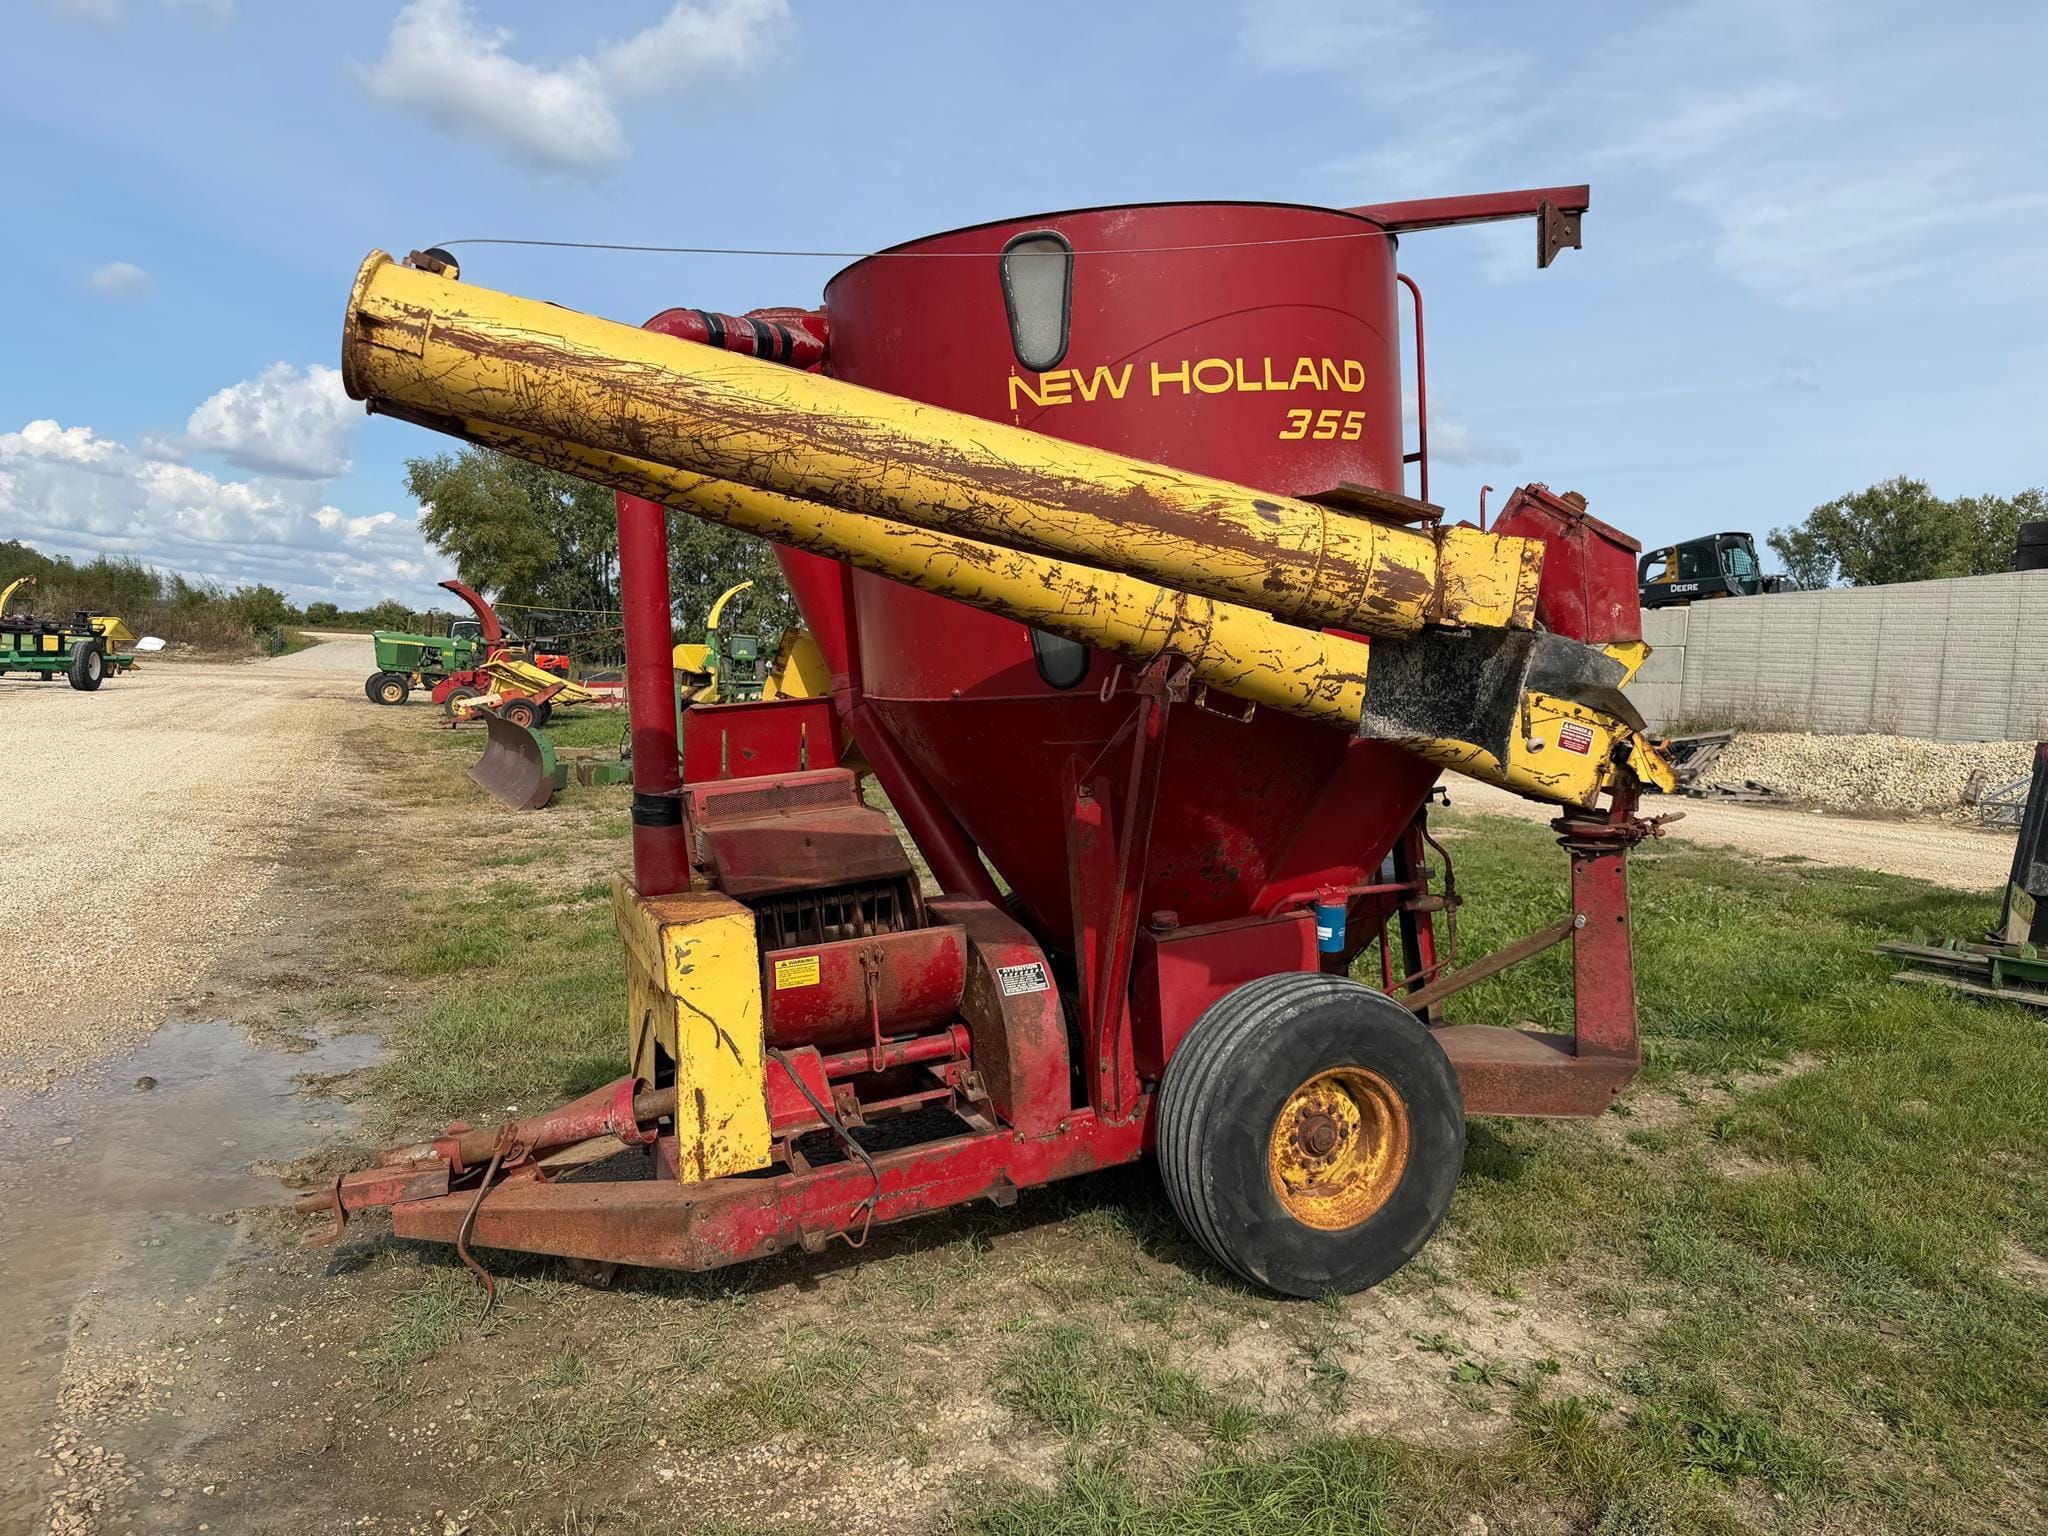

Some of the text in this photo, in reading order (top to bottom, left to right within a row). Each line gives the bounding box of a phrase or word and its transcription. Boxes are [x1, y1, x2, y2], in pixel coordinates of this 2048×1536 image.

[1008, 357, 1365, 410] NEW HOLLAND
[1279, 408, 1366, 440] 355
[1670, 583, 1698, 593] DEERE
[1002, 964, 1038, 973] ATTENTION
